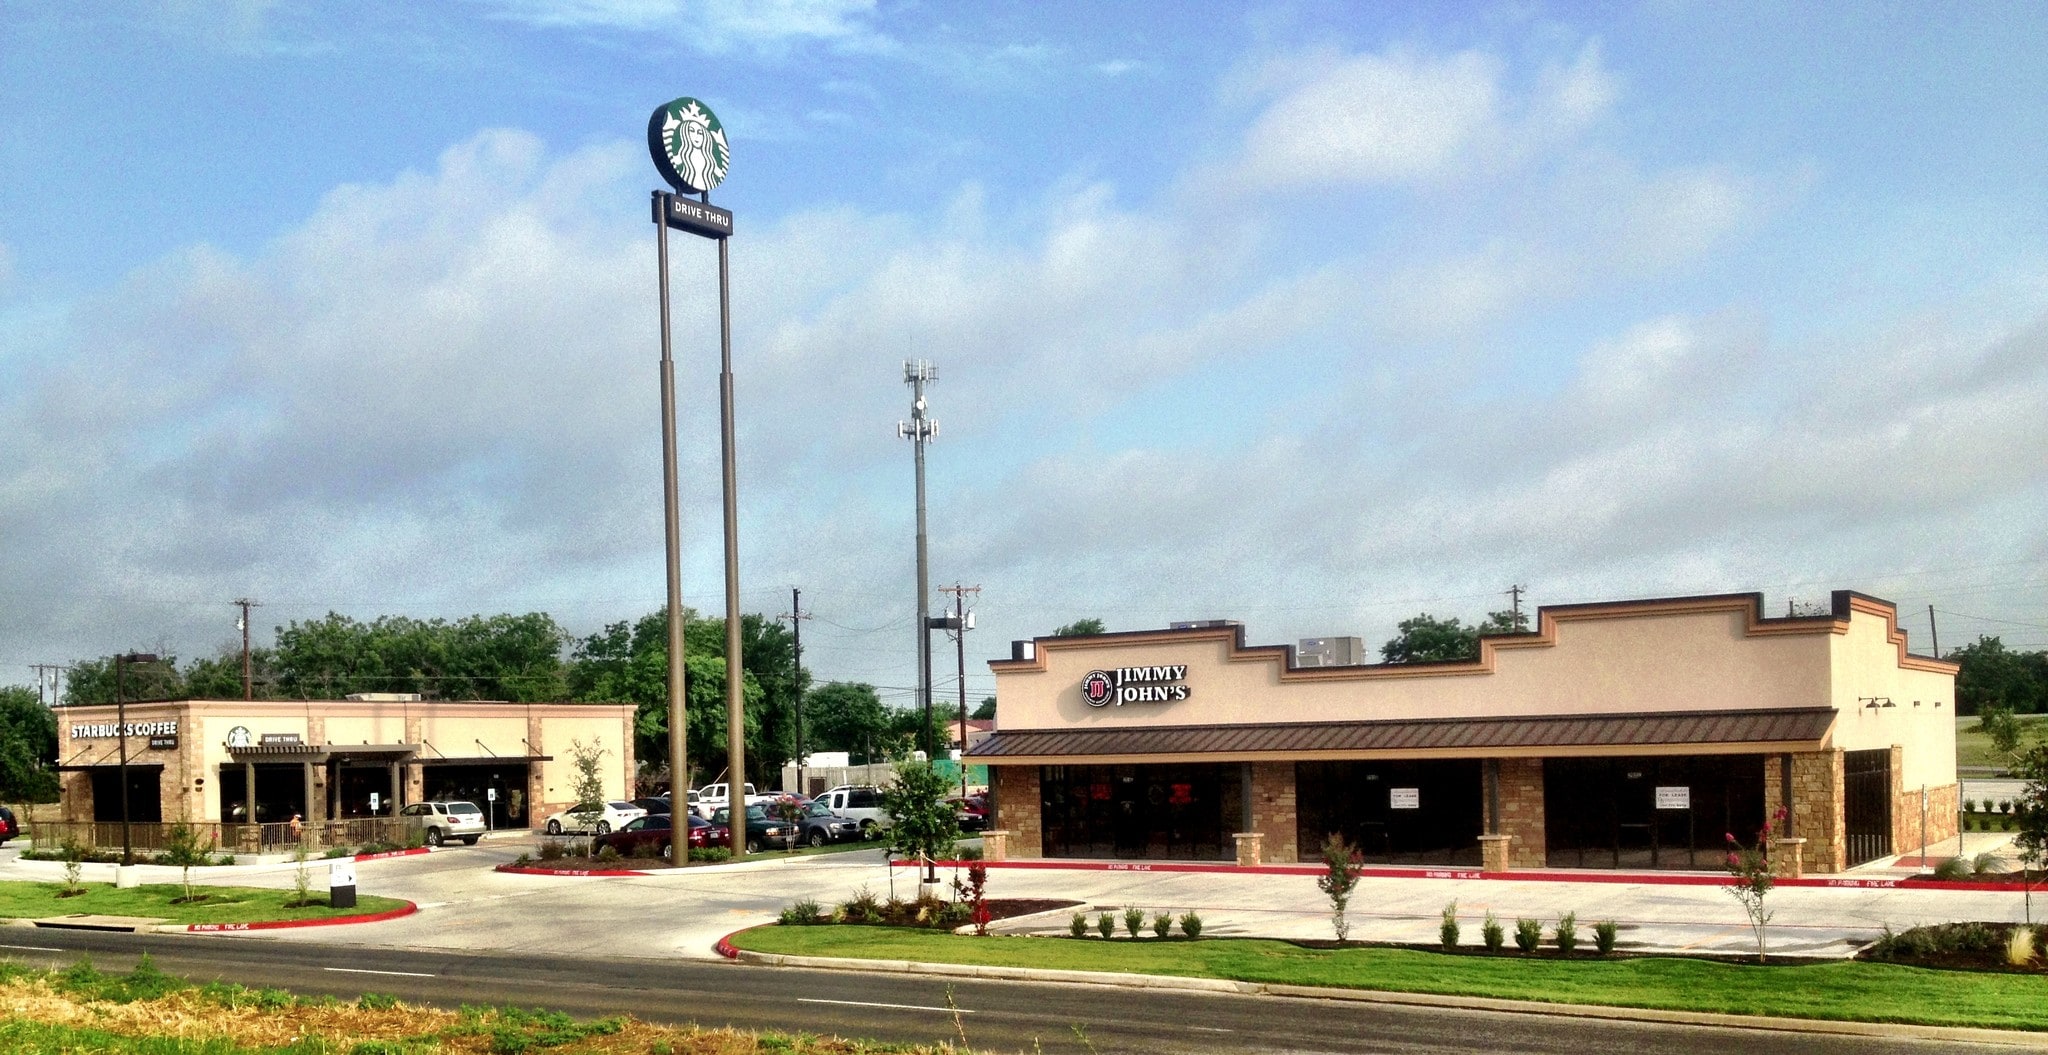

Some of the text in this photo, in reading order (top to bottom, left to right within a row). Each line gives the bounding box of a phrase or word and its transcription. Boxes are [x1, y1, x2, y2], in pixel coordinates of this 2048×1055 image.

[675, 201, 729, 227] DRIVE THRU
[1116, 665, 1185, 687] JIMMY
[1116, 685, 1187, 706] JOHN'S
[71, 721, 178, 738] STARBUCS COFFEE
